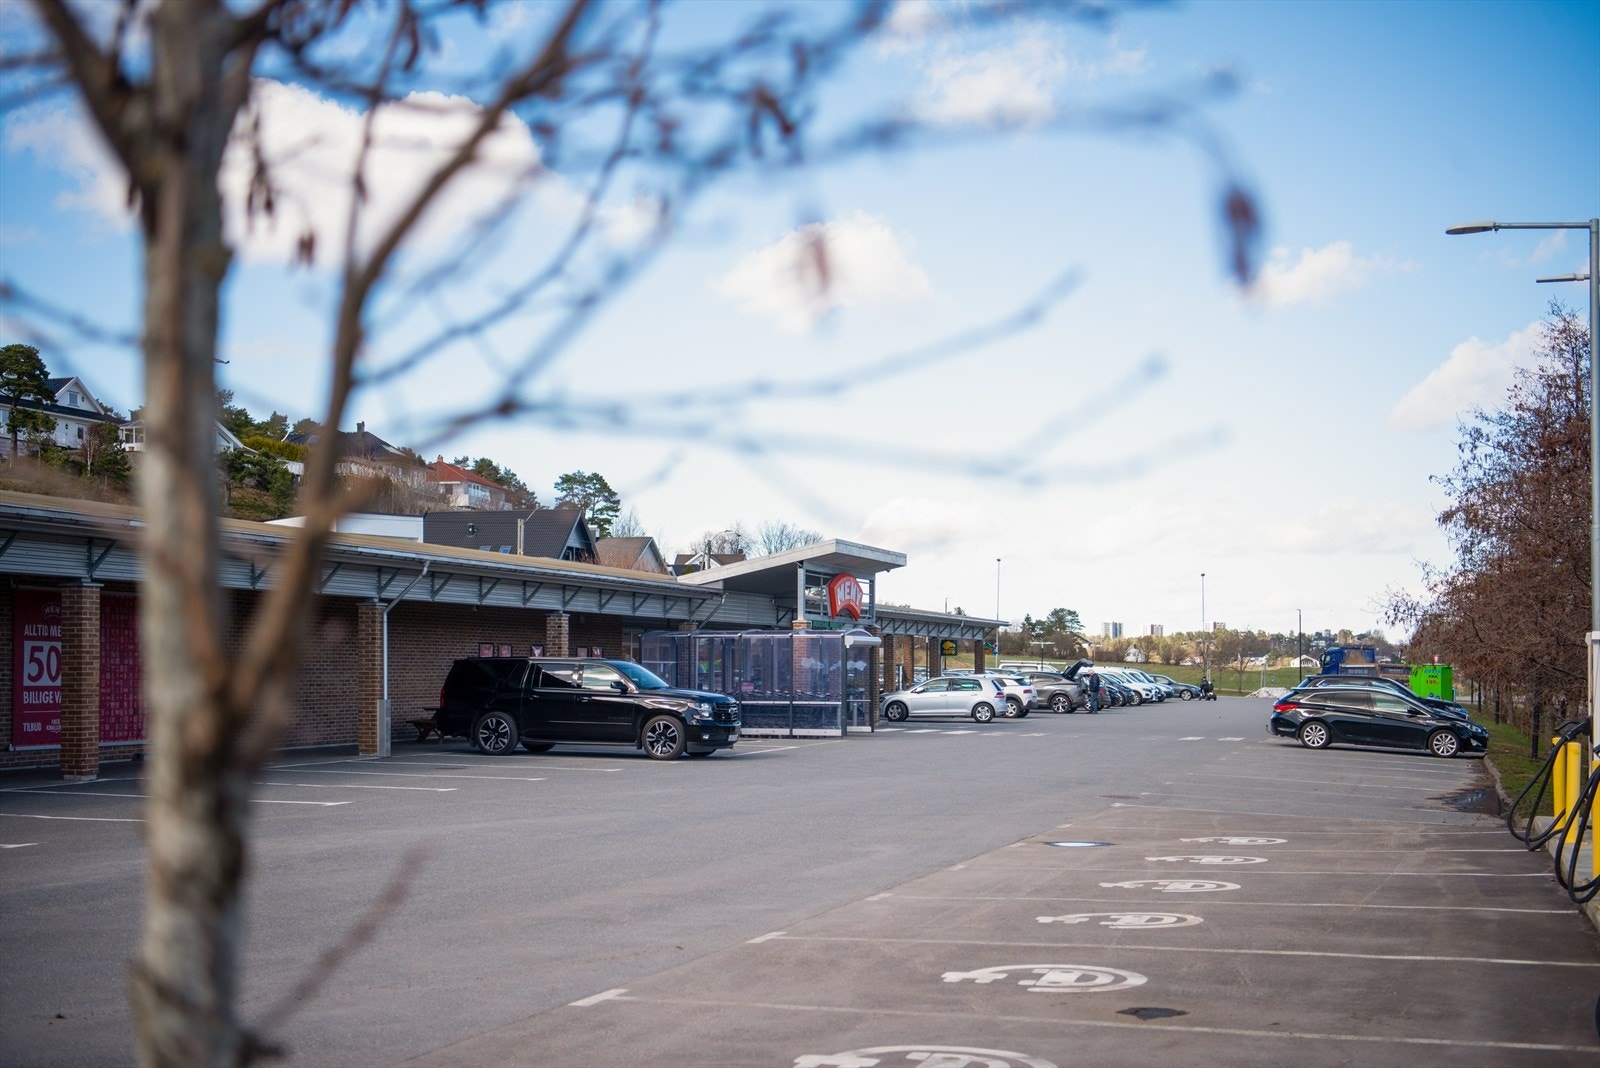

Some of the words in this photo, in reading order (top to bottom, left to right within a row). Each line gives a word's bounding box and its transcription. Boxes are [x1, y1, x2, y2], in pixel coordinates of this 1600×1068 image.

[837, 581, 862, 606] MENY
[44, 605, 61, 615] MEN
[24, 624, 49, 636] ALLTID
[50, 625, 62, 637] ME
[27, 645, 62, 682] 50
[23, 691, 53, 704] BILLIGE
